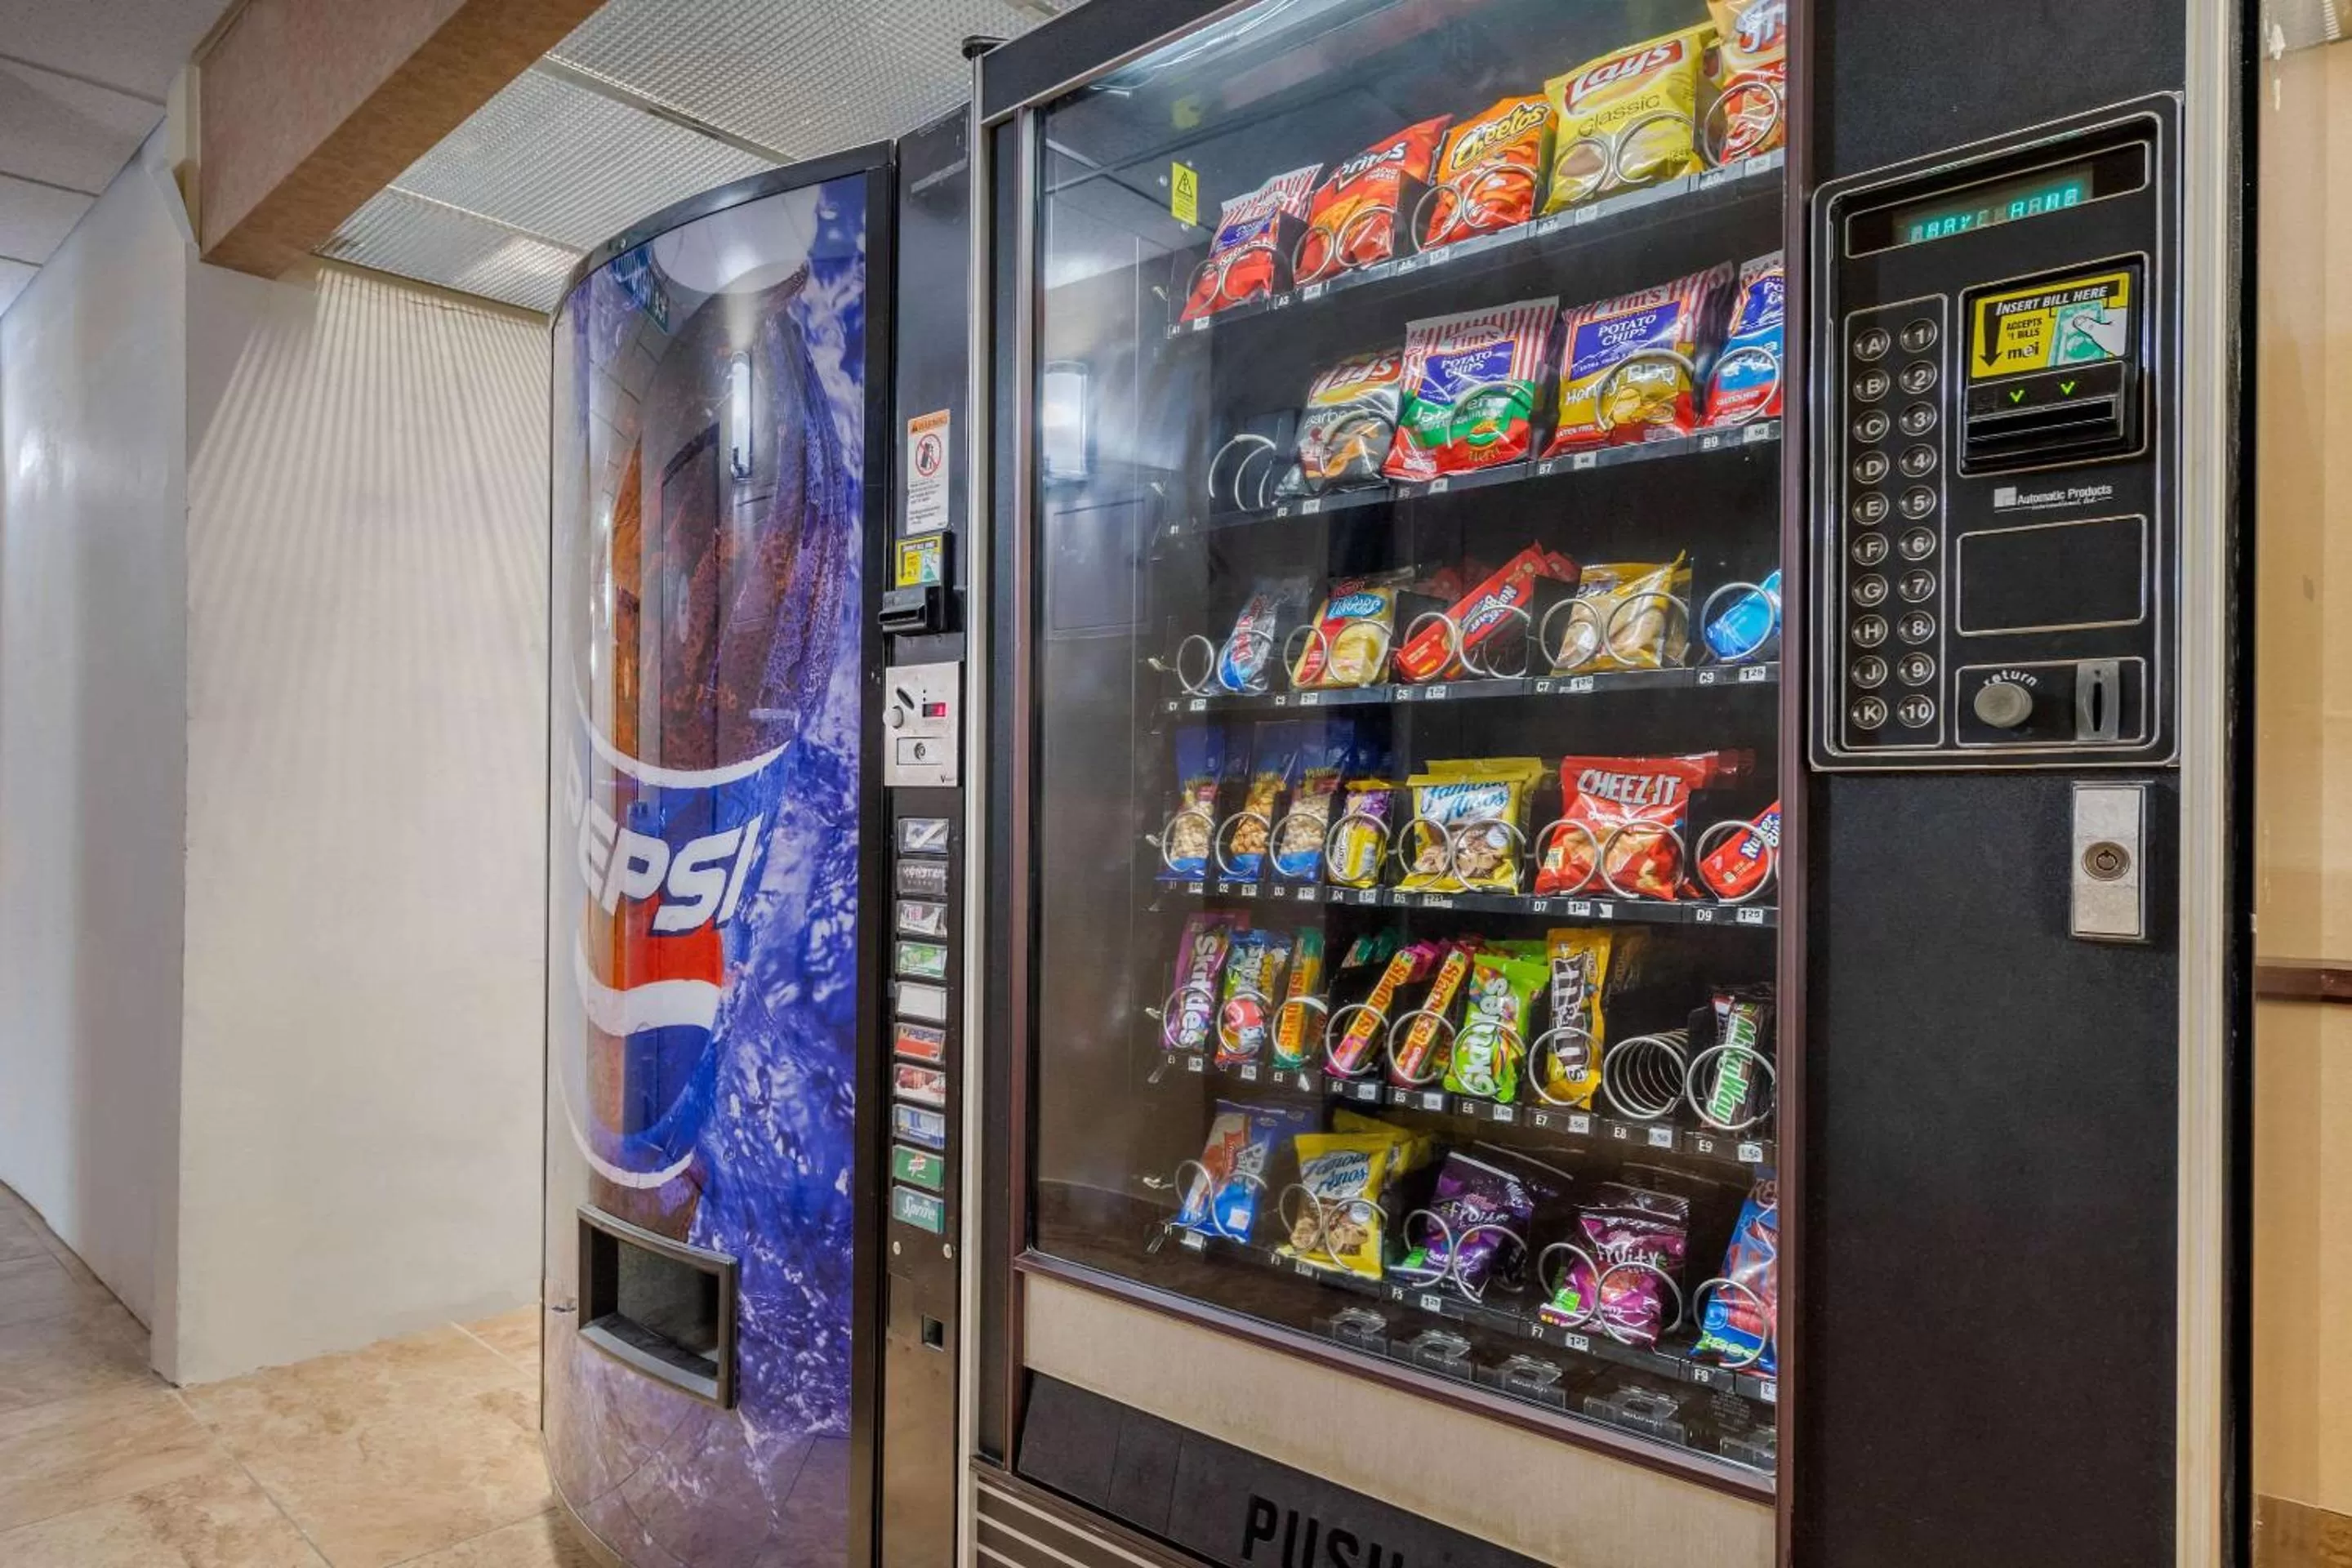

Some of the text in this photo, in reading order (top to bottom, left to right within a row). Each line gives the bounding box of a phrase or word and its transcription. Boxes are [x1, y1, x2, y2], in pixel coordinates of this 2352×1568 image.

[1578, 95, 1661, 138] Classic
[1453, 103, 1549, 169] Cheetos
[1995, 286, 2109, 316] INSERT BILL HERE
[1598, 314, 1656, 336] POTATO
[2007, 317, 2042, 331] ACCEPTS
[1602, 326, 1647, 346] CHIPS
[1915, 328, 1926, 344] 1
[2017, 327, 2039, 339] BILLS
[1867, 337, 1879, 352] A
[1441, 350, 1493, 370] POTATO
[1913, 370, 1926, 385] 2
[1867, 378, 1879, 394] B
[1867, 419, 1880, 434] C
[1914, 412, 1926, 427] 3
[1867, 461, 1878, 475] D
[1913, 453, 1926, 468] 4
[1913, 495, 1925, 510] 5
[2017, 490, 2065, 506] Automatic
[2068, 484, 2113, 498] Products
[1867, 501, 1878, 516] E
[1867, 542, 1878, 556] F
[1913, 537, 1925, 552] 6
[1865, 583, 1879, 598] G
[1913, 579, 1925, 593] 7
[1865, 625, 1878, 639] H
[1913, 621, 1925, 635] 8
[1867, 666, 1877, 679] J
[1912, 663, 1923, 677] 9
[1699, 672, 1714, 684] C9
[1982, 668, 2038, 688] return
[1537, 681, 1550, 693] C7
[1865, 706, 1878, 719] K
[1906, 704, 1928, 719] 10
[1534, 901, 1548, 912] D7
[1696, 909, 1712, 921] D9
[1536, 1115, 1548, 1126] E7
[1614, 1126, 1628, 1139] E8
[1699, 1140, 1713, 1152] E9
[902, 1196, 936, 1220] Sprite
